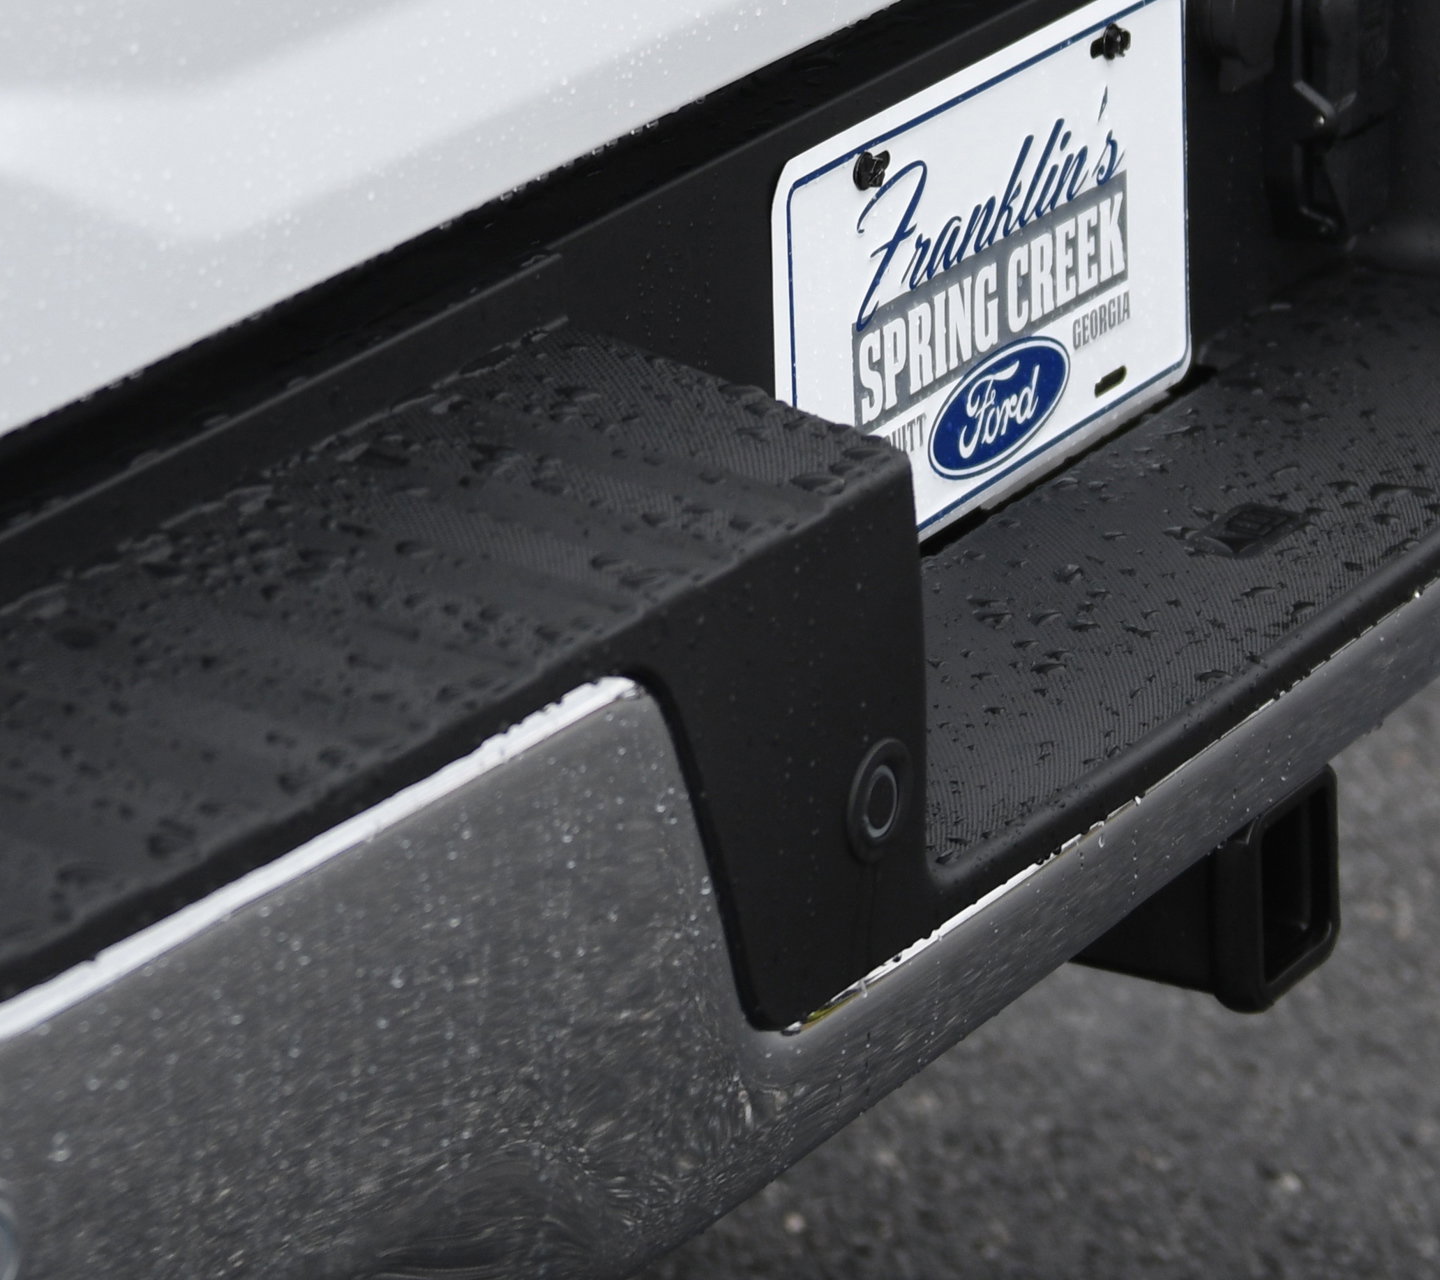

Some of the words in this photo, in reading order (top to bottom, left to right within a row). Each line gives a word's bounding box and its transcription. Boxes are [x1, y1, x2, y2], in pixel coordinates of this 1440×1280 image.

[856, 86, 1125, 331] Franklin's
[859, 264, 999, 426] SPRING
[1006, 190, 1125, 334] CREEK
[1072, 290, 1130, 351] GEORGIA
[883, 412, 927, 453] UITT
[958, 358, 1040, 461] Ford
